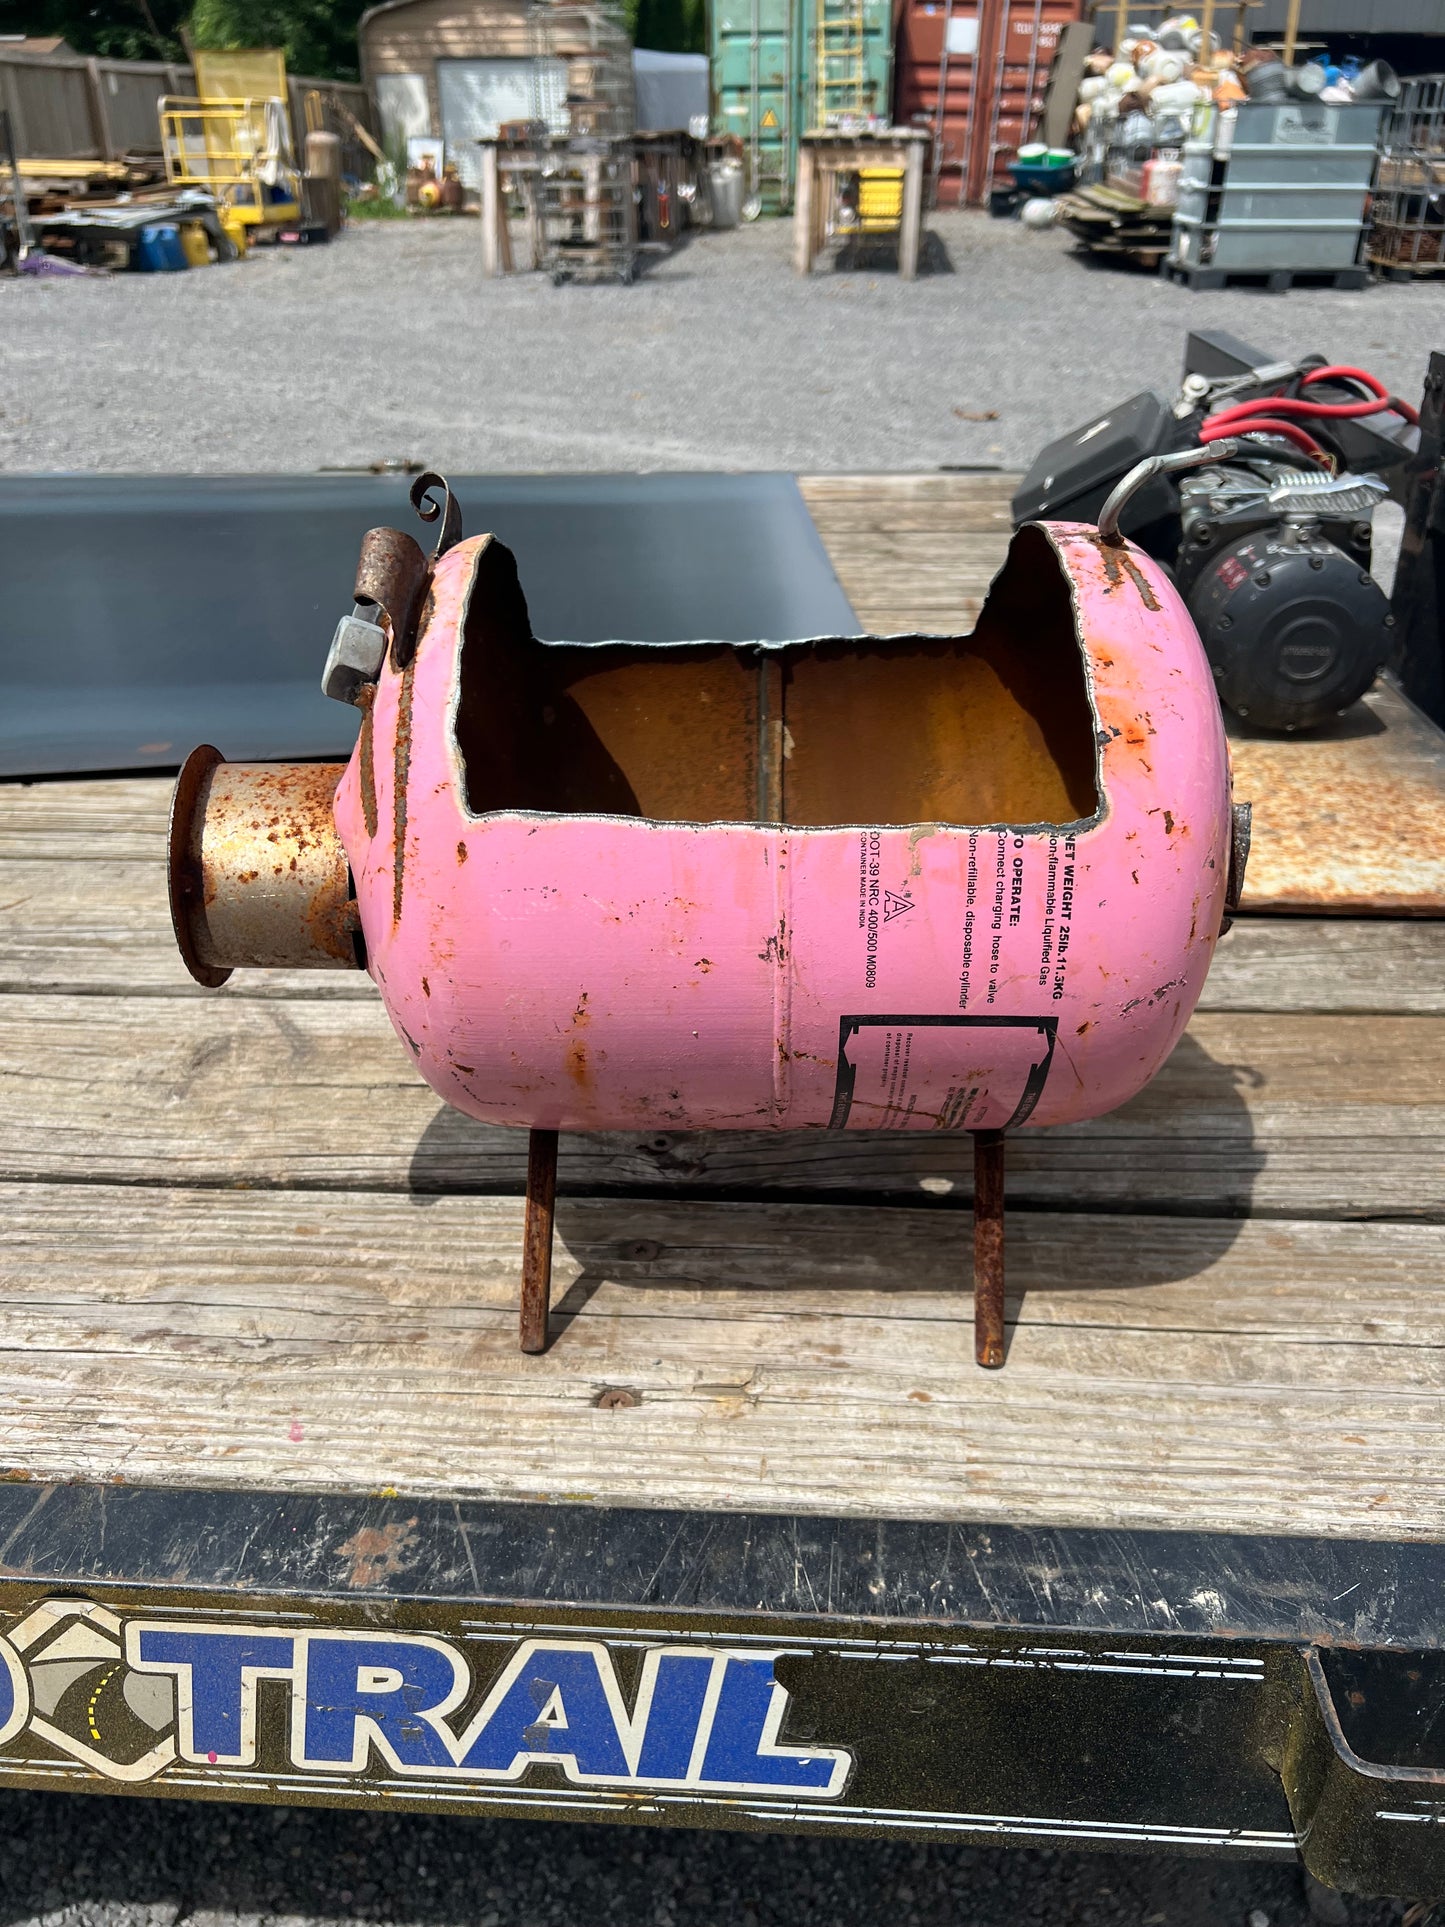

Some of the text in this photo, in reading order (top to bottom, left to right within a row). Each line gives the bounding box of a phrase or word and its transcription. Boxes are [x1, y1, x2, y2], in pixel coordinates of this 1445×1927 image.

[865, 832, 880, 988] DOT-39 NRC 400/500 M0809
[987, 831, 1008, 1003] Connect charging hose to valve
[1010, 858, 1023, 926] OPERATE:
[1061, 865, 1074, 920] WEIGHT
[962, 911, 976, 968] disposable
[1053, 926, 1070, 999] 25lb.11.3KG
[959, 971, 971, 1009] cylinder
[1039, 967, 1050, 985] Gas
[128, 1621, 850, 1797] TRAIL
